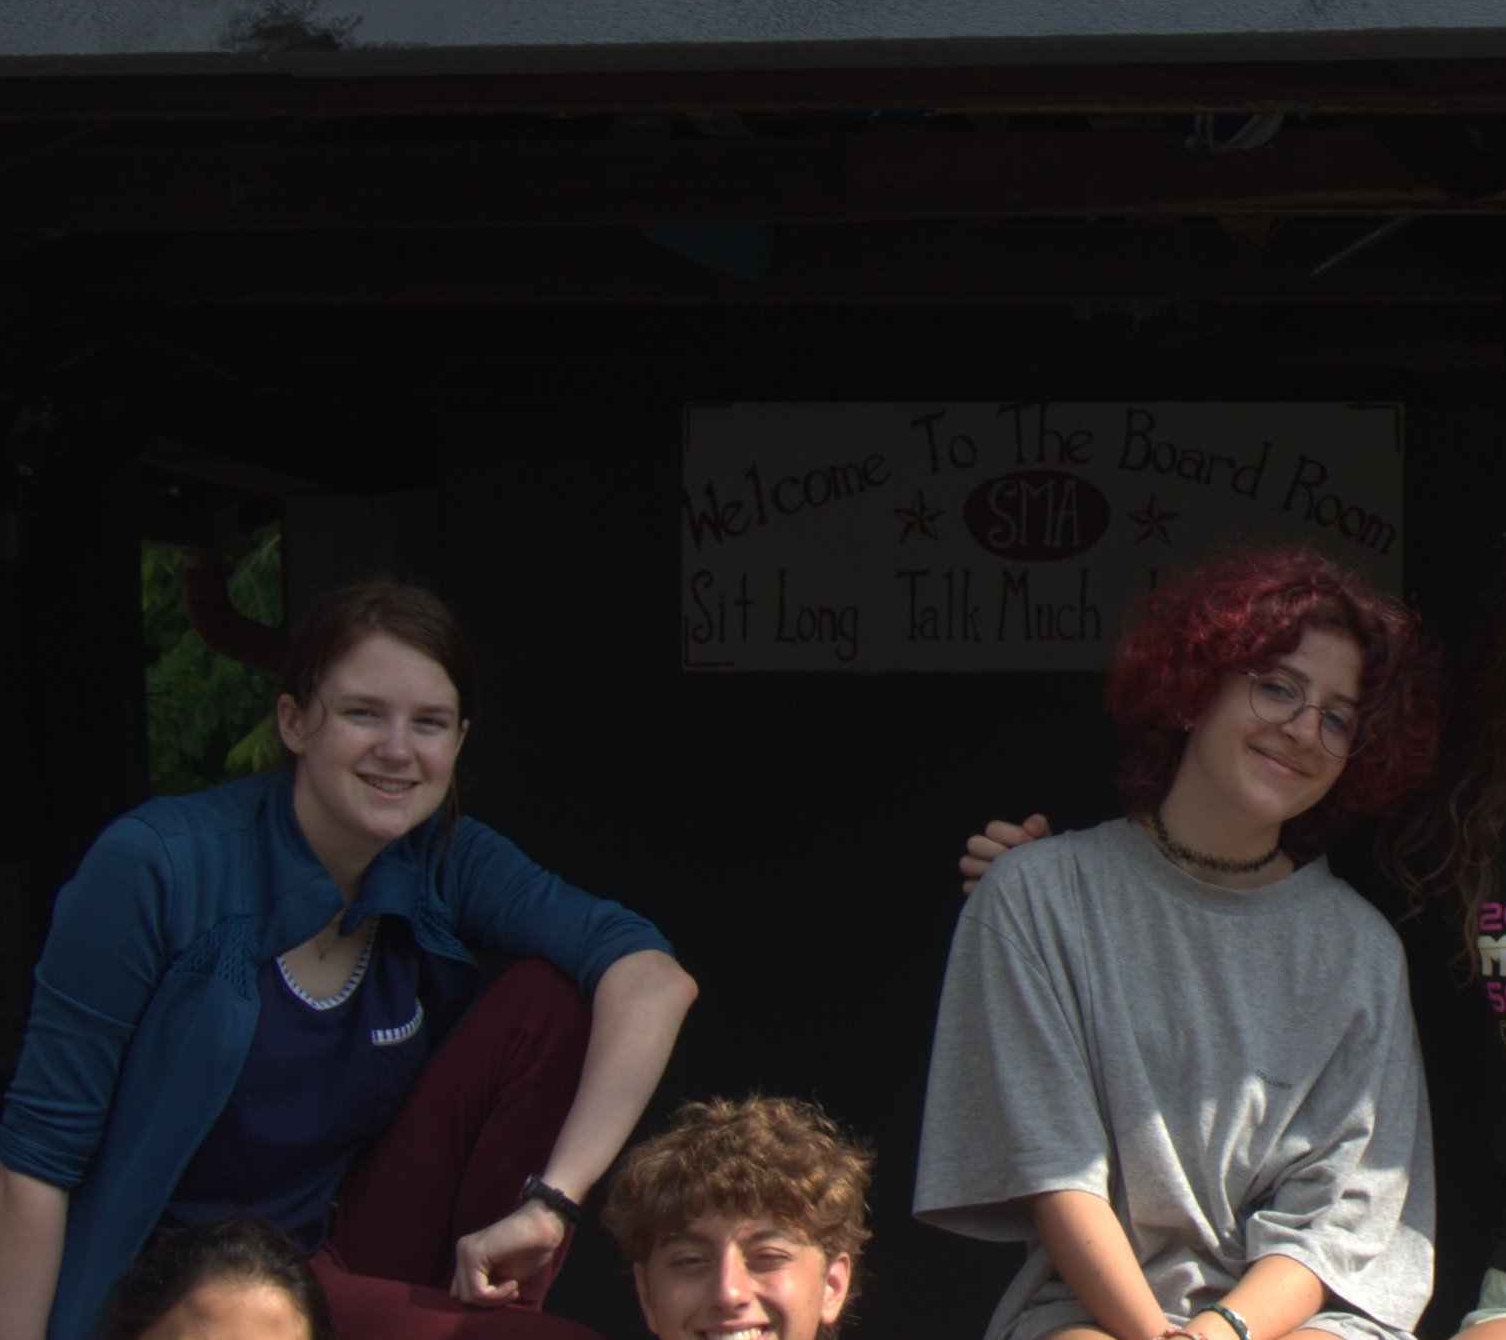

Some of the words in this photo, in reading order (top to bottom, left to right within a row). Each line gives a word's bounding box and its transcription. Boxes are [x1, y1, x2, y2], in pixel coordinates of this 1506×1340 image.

[682, 451, 892, 549] Welcome
[910, 409, 977, 476] To
[998, 403, 1095, 466] The
[1117, 407, 1272, 500] Board
[1281, 454, 1398, 555] Room
[988, 476, 1081, 550] SMA
[691, 568, 754, 645] Sit
[773, 568, 860, 662] Long
[896, 569, 983, 642] Talk
[997, 569, 1103, 643] Much
